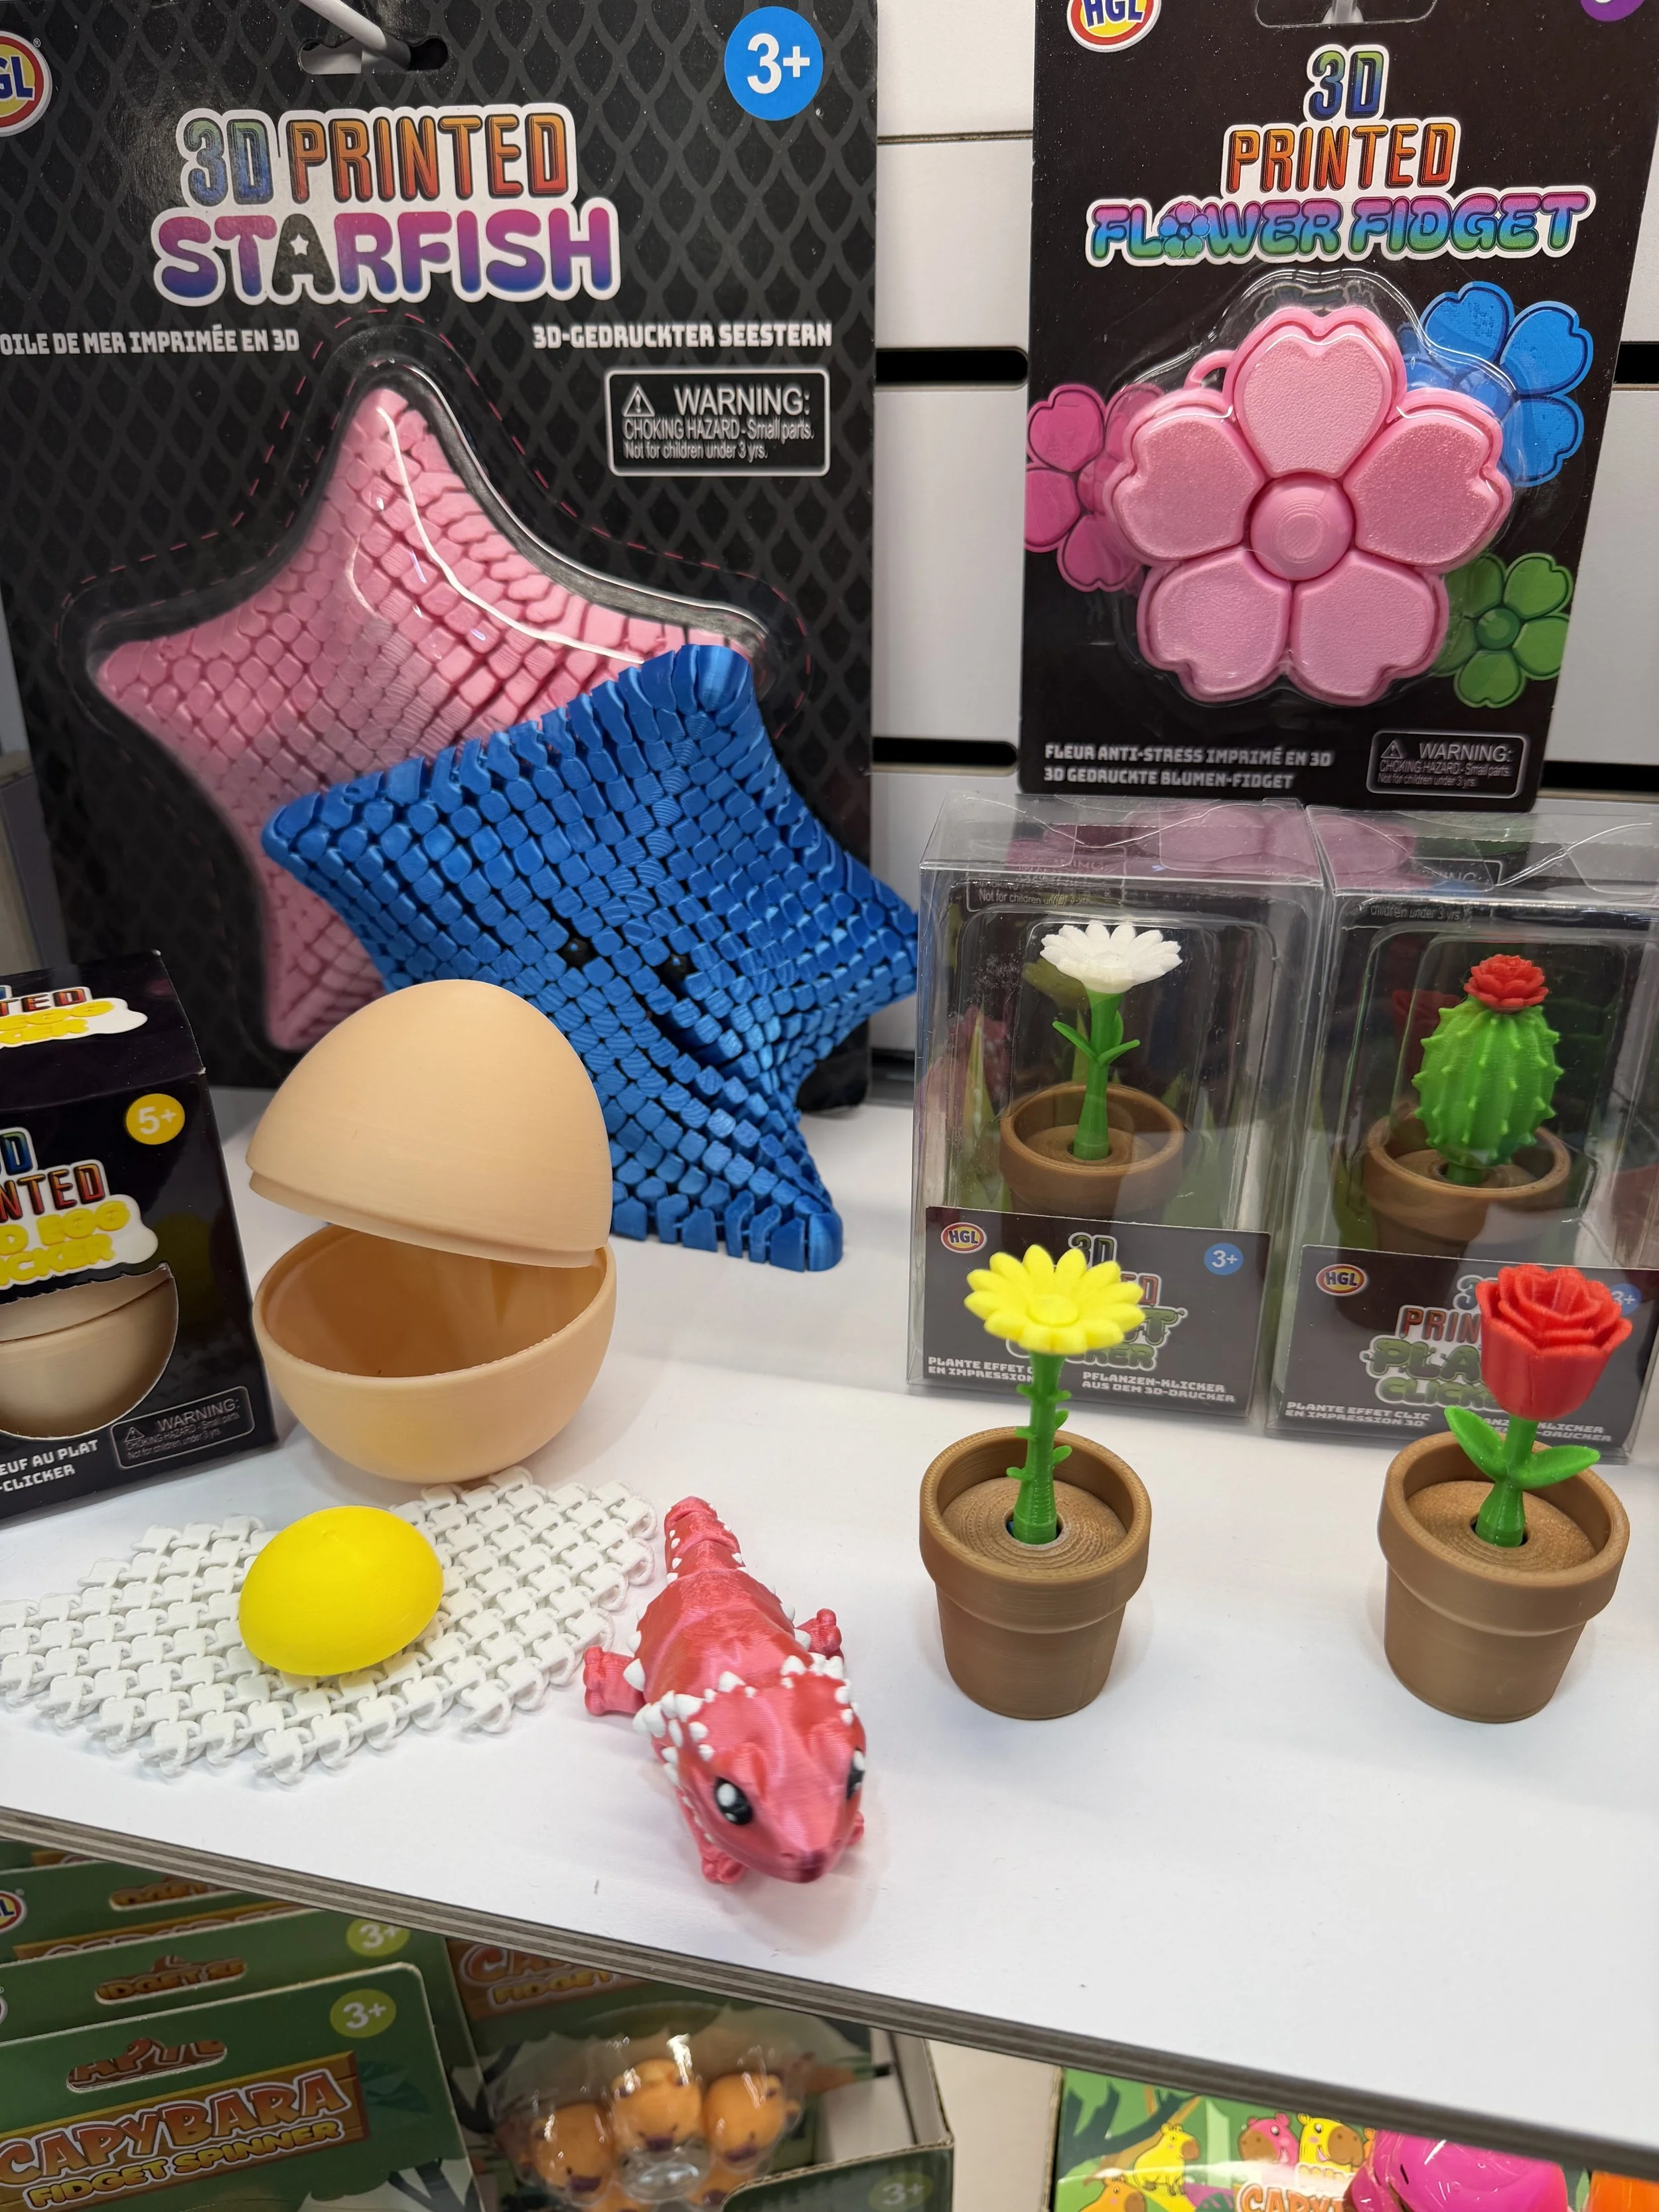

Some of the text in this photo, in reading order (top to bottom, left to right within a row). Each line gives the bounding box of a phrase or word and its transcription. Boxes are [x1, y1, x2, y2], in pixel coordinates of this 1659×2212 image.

[1083, 0, 1145, 28] HGL
[746, 33, 810, 94] 3+
[1310, 51, 1385, 121] 3D
[183, 111, 569, 205] 3D PRINTED
[1226, 121, 1457, 194] PRINTED
[1349, 192, 1589, 258] FIDGET
[157, 206, 618, 299] STARFISH
[54, 332, 80, 354] DE
[82, 332, 127, 354] MER
[130, 324, 238, 353] IMPRIMÉE
[240, 330, 269, 352] EN
[272, 329, 300, 352] 3D
[533, 322, 833, 348] 3D-GEDRUCKTER SEESTERN
[673, 383, 810, 416] WARNING:
[622, 416, 685, 441] CHOKING
[623, 439, 644, 459] Not
[645, 439, 661, 459] for
[663, 439, 703, 459] children
[705, 439, 736, 459] under
[737, 440, 747, 459] 3
[1045, 744, 1334, 767] FLEUR ANTI-STRESS IMPRIMÉ EN 3D
[1419, 741, 1515, 763] WARNING:
[1044, 767, 1294, 789] 3D GEDRUCKTE BLUMEN-FIDGET
[979, 889, 994, 902] Not
[996, 889, 1007, 903] for
[1009, 893, 1041, 904] children
[138, 1105, 177, 1135] 5+
[36, 1200, 131, 1246] EGG
[948, 1230, 979, 1245] HGL
[1211, 1250, 1238, 1268] 3+
[1323, 1271, 1358, 1288] HGL
[1399, 1307, 1482, 1344] PRIN
[928, 1356, 981, 1369] PLANTE
[983, 1361, 1025, 1374] EFFET
[928, 1366, 946, 1374] EN
[948, 1367, 1034, 1382] IMPRESSION
[1368, 1337, 1482, 1384] PLA
[1081, 1380, 1235, 1402] AUS DEM 3D-DRUCKER
[1082, 1370, 1226, 1394] PFLANZEN-KLICKER
[157, 1398, 240, 1432] WARNING:
[1285, 1409, 1304, 1418] EN
[1307, 1411, 1403, 1426] IMPRESSION
[1286, 1401, 1431, 1420] PLANTE EFFET CLIC
[33, 1451, 55, 1468] AU
[57, 1439, 99, 1460] PLAT
[358, 1923, 401, 1949] 3+
[342, 2001, 387, 2029] 3+
[0, 2073, 348, 2184] CAPYBARA
[28, 2120, 341, 2210] FIDGET SPINNER
[882, 2182, 925, 2205] 3+
